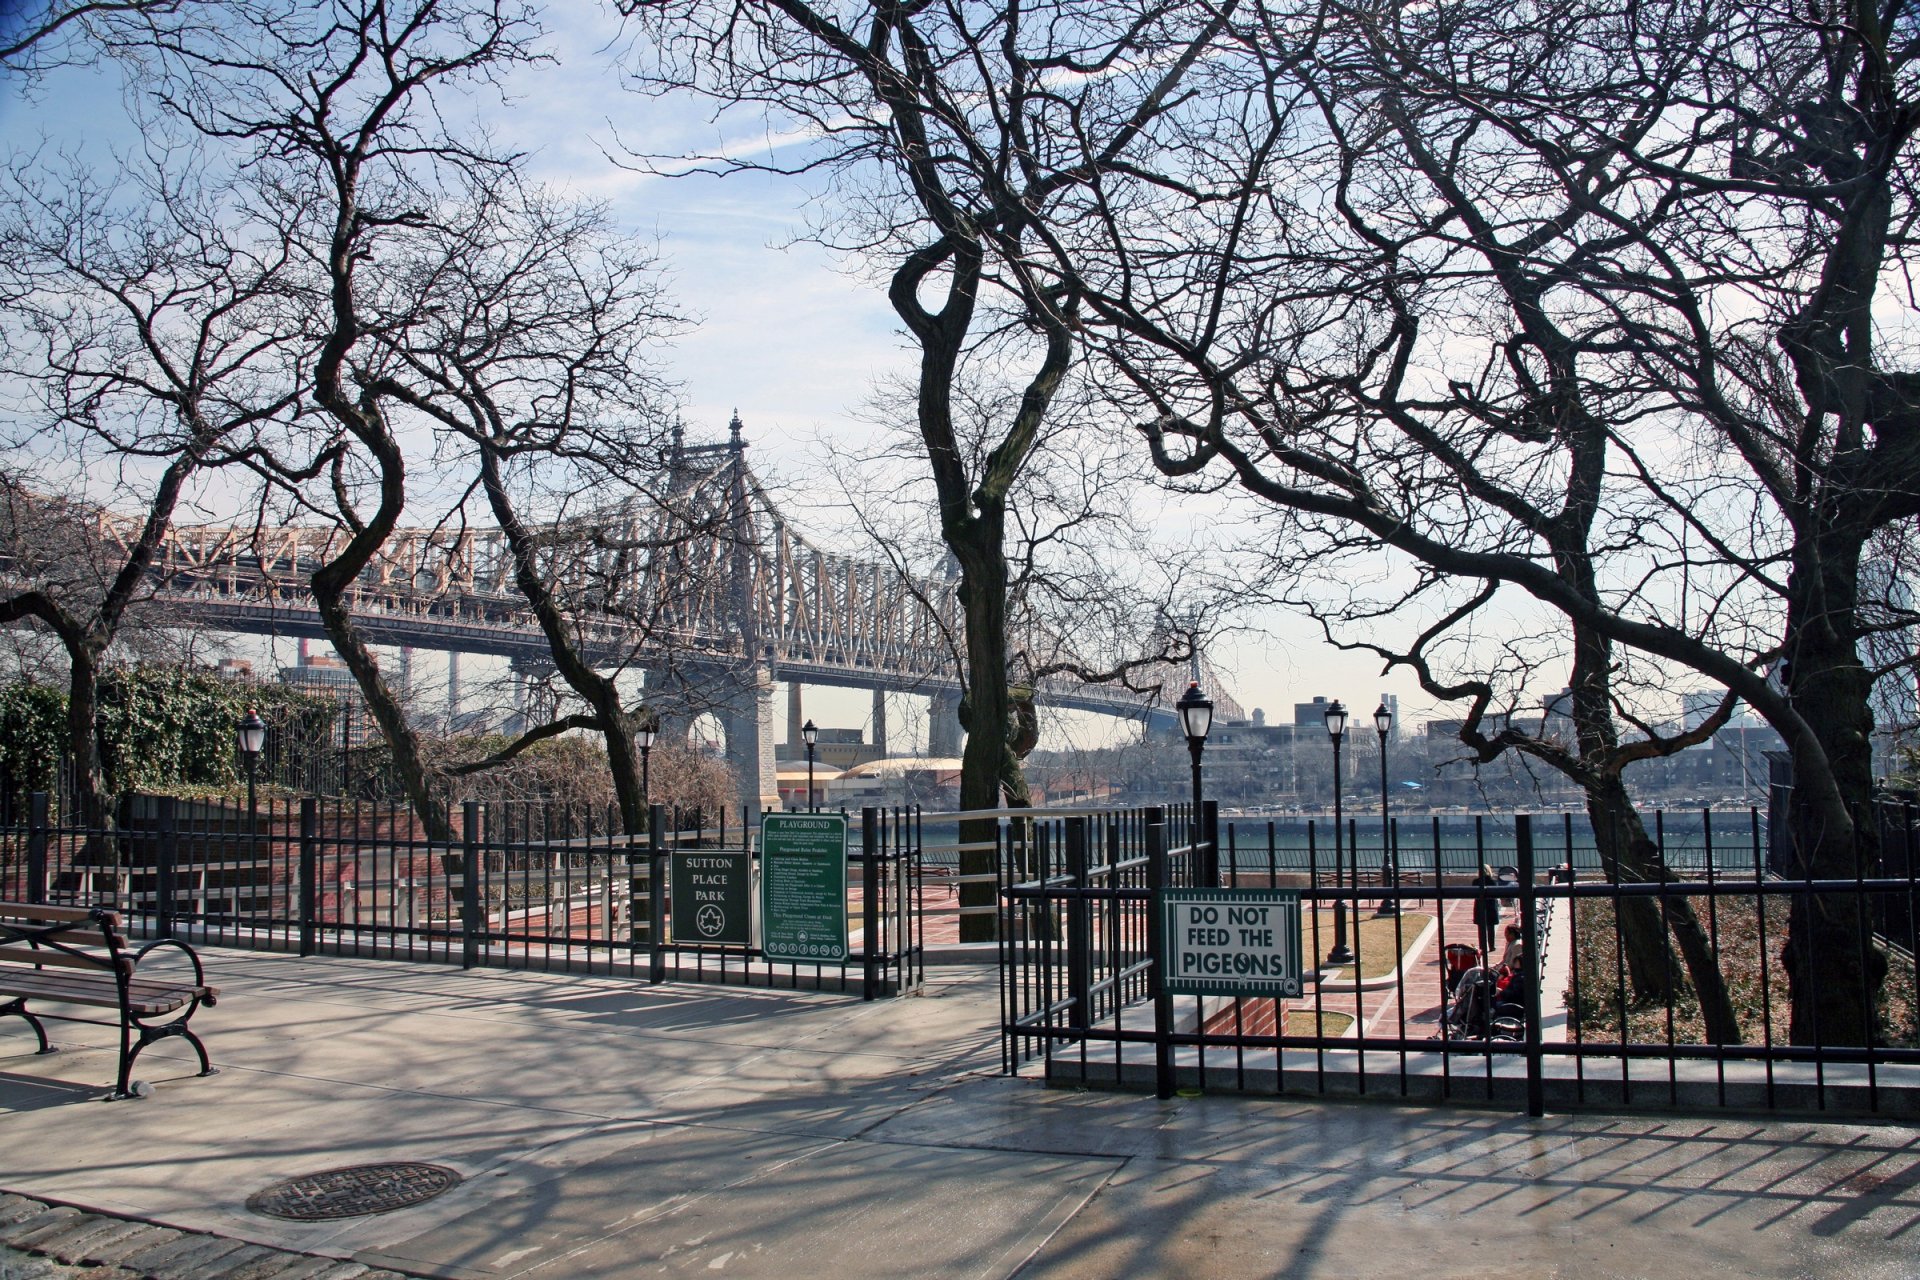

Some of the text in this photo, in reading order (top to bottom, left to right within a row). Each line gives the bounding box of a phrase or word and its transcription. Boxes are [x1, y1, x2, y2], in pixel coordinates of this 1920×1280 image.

[779, 820, 830, 829] PLAYGROUND
[686, 857, 733, 868] SUTTON
[692, 874, 728, 884] PLACE
[695, 890, 725, 900] PARK
[1190, 907, 1269, 925] DO NOT
[1187, 928, 1273, 947] FEED THE
[1182, 952, 1283, 976] PIGEONS
